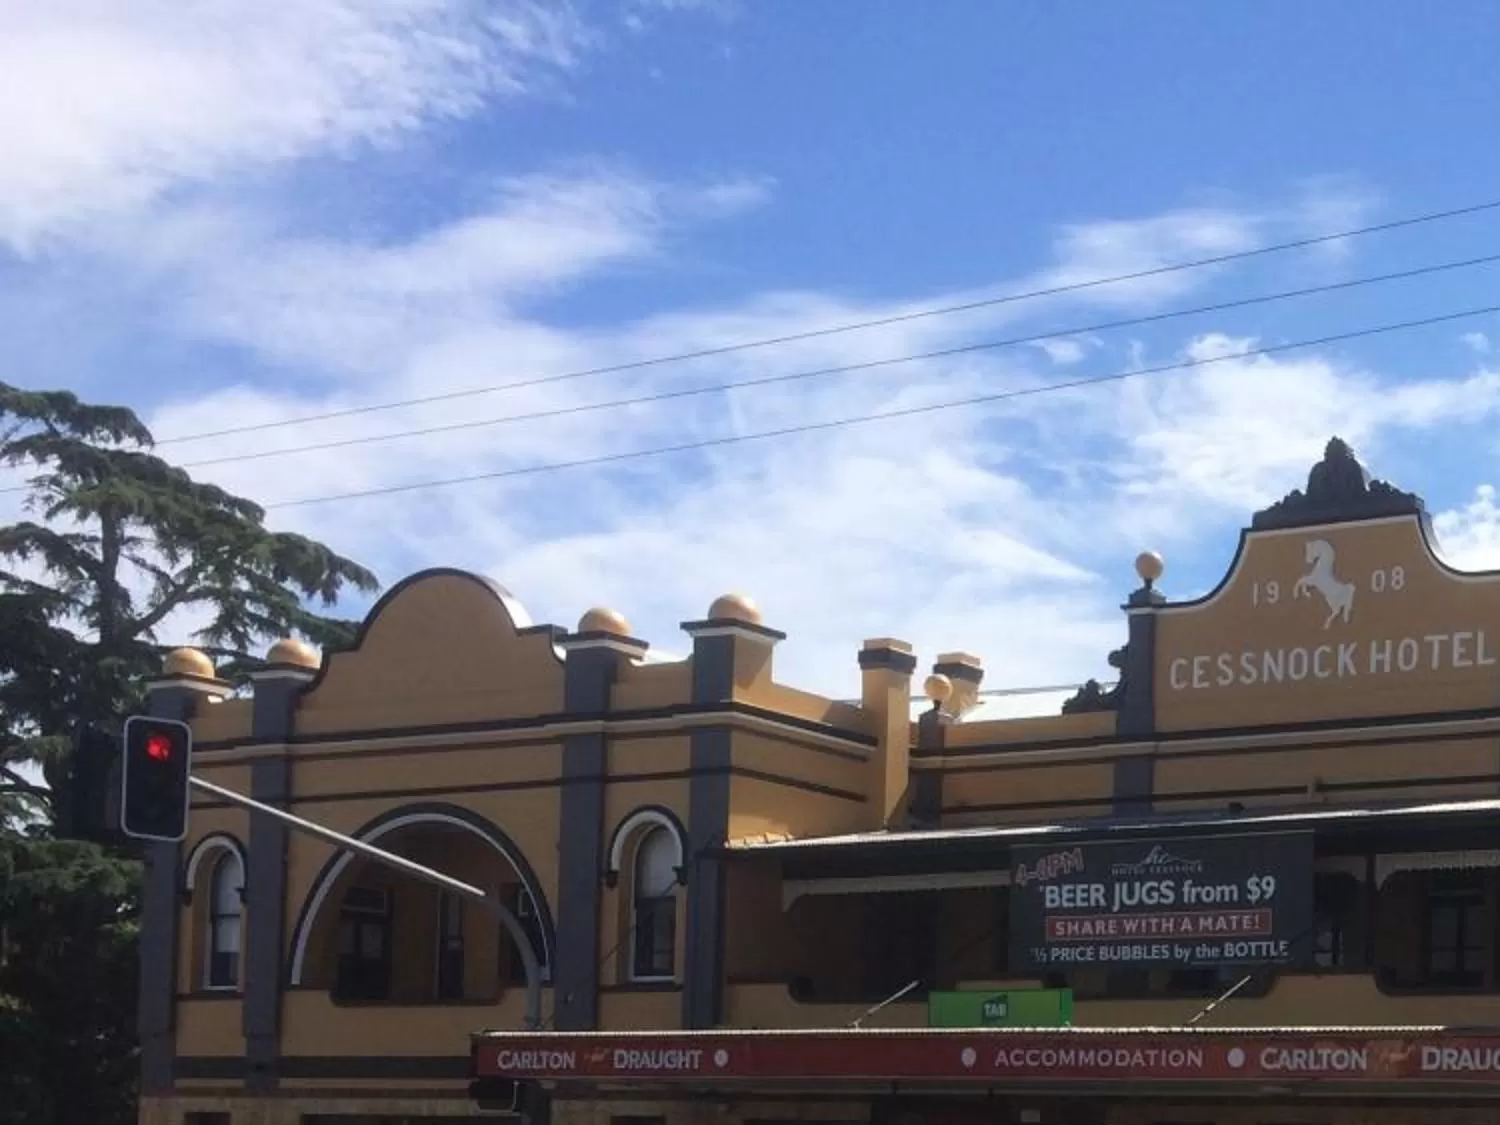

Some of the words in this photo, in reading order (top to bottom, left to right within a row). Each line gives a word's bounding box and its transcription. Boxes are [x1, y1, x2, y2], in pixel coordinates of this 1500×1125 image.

[1169, 642, 1357, 690] CESSNOCK
[1369, 631, 1496, 674] HOTEL
[1044, 884, 1107, 909] BEER
[1112, 880, 1176, 912] JUGS
[1182, 879, 1239, 905] from
[1246, 875, 1277, 905] $9
[1055, 919, 1118, 936] SHARE
[1122, 917, 1175, 934] WITH
[1180, 917, 1194, 932] A
[1199, 914, 1261, 931] MATE!
[1051, 945, 1097, 961] PRICE
[1099, 943, 1170, 961] BUBBLES
[1174, 943, 1191, 963] by
[1195, 943, 1221, 959] the
[1223, 940, 1290, 958] BOTTLE
[497, 1049, 577, 1069] CARLTON
[613, 1048, 703, 1069] DRAUGHT
[994, 1049, 1203, 1068] ACCOMMODATION
[1259, 1047, 1368, 1071] CARLTON
